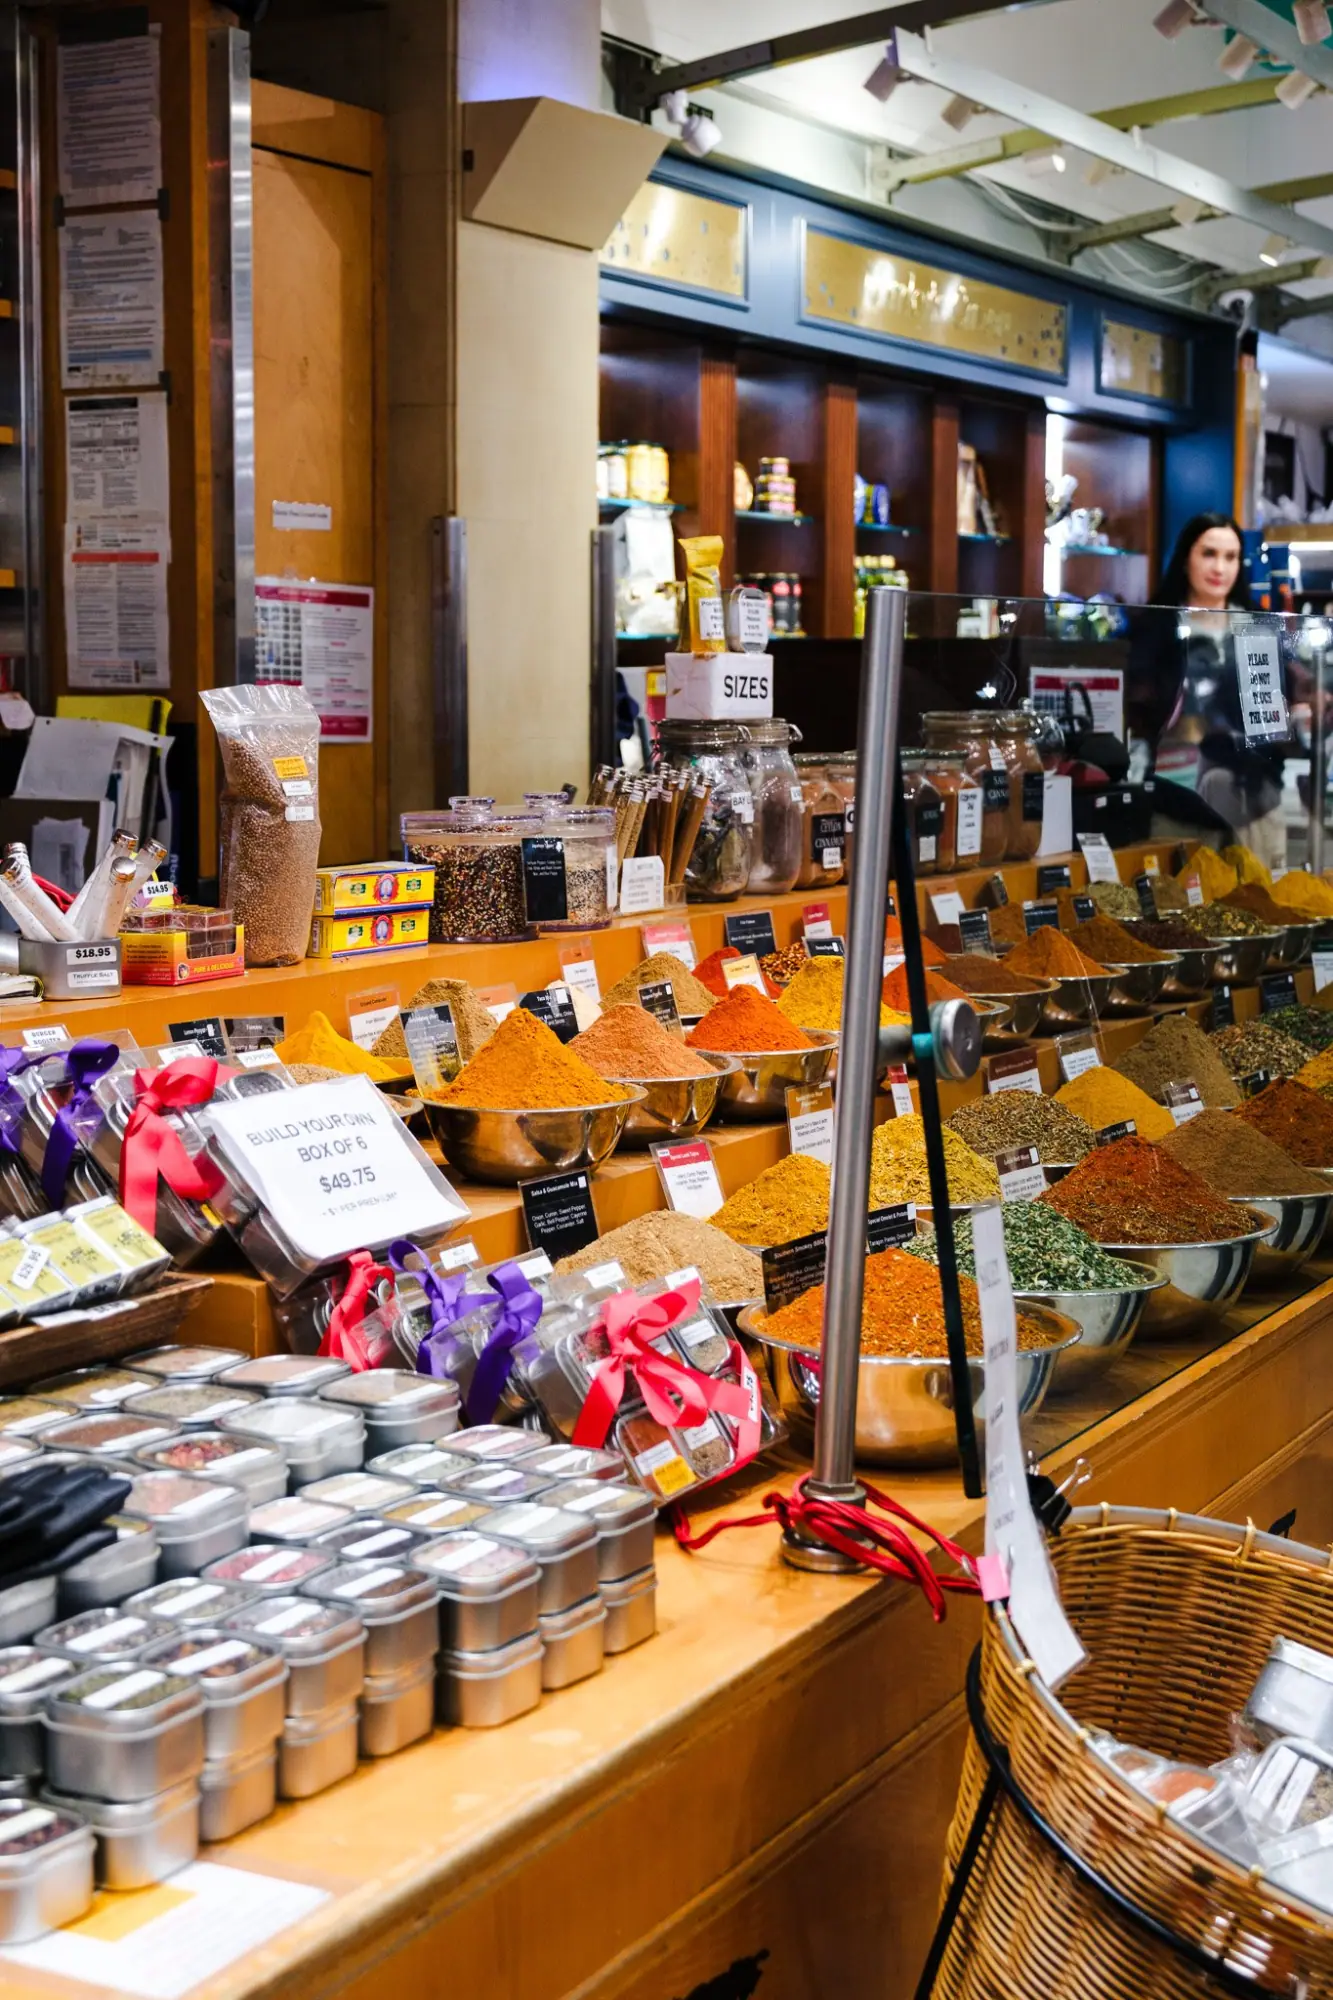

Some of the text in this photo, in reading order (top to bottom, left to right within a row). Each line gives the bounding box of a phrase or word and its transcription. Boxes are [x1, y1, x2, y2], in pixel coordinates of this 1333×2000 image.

[1248, 653, 1269, 666] PLEASE
[1250, 673, 1270, 685] DO NOT
[724, 675, 768, 699] SIZES
[147, 884, 169, 895] $14.95
[75, 948, 111, 959] $18.95
[73, 971, 114, 981] TRUFFLE SALT
[31, 1029, 56, 1038] BURGER
[247, 1112, 377, 1147] BUILD YOUR OWN
[297, 1136, 368, 1162] BOX OF 6
[319, 1166, 376, 1194] $49.75
[531, 1189, 543, 1197] Salsa
[546, 1182, 570, 1193] Guacamole
[867, 1216, 880, 1225] Special
[880, 1213, 893, 1222] Omelet
[774, 1238, 825, 1259] Southern Smokey BBQ
